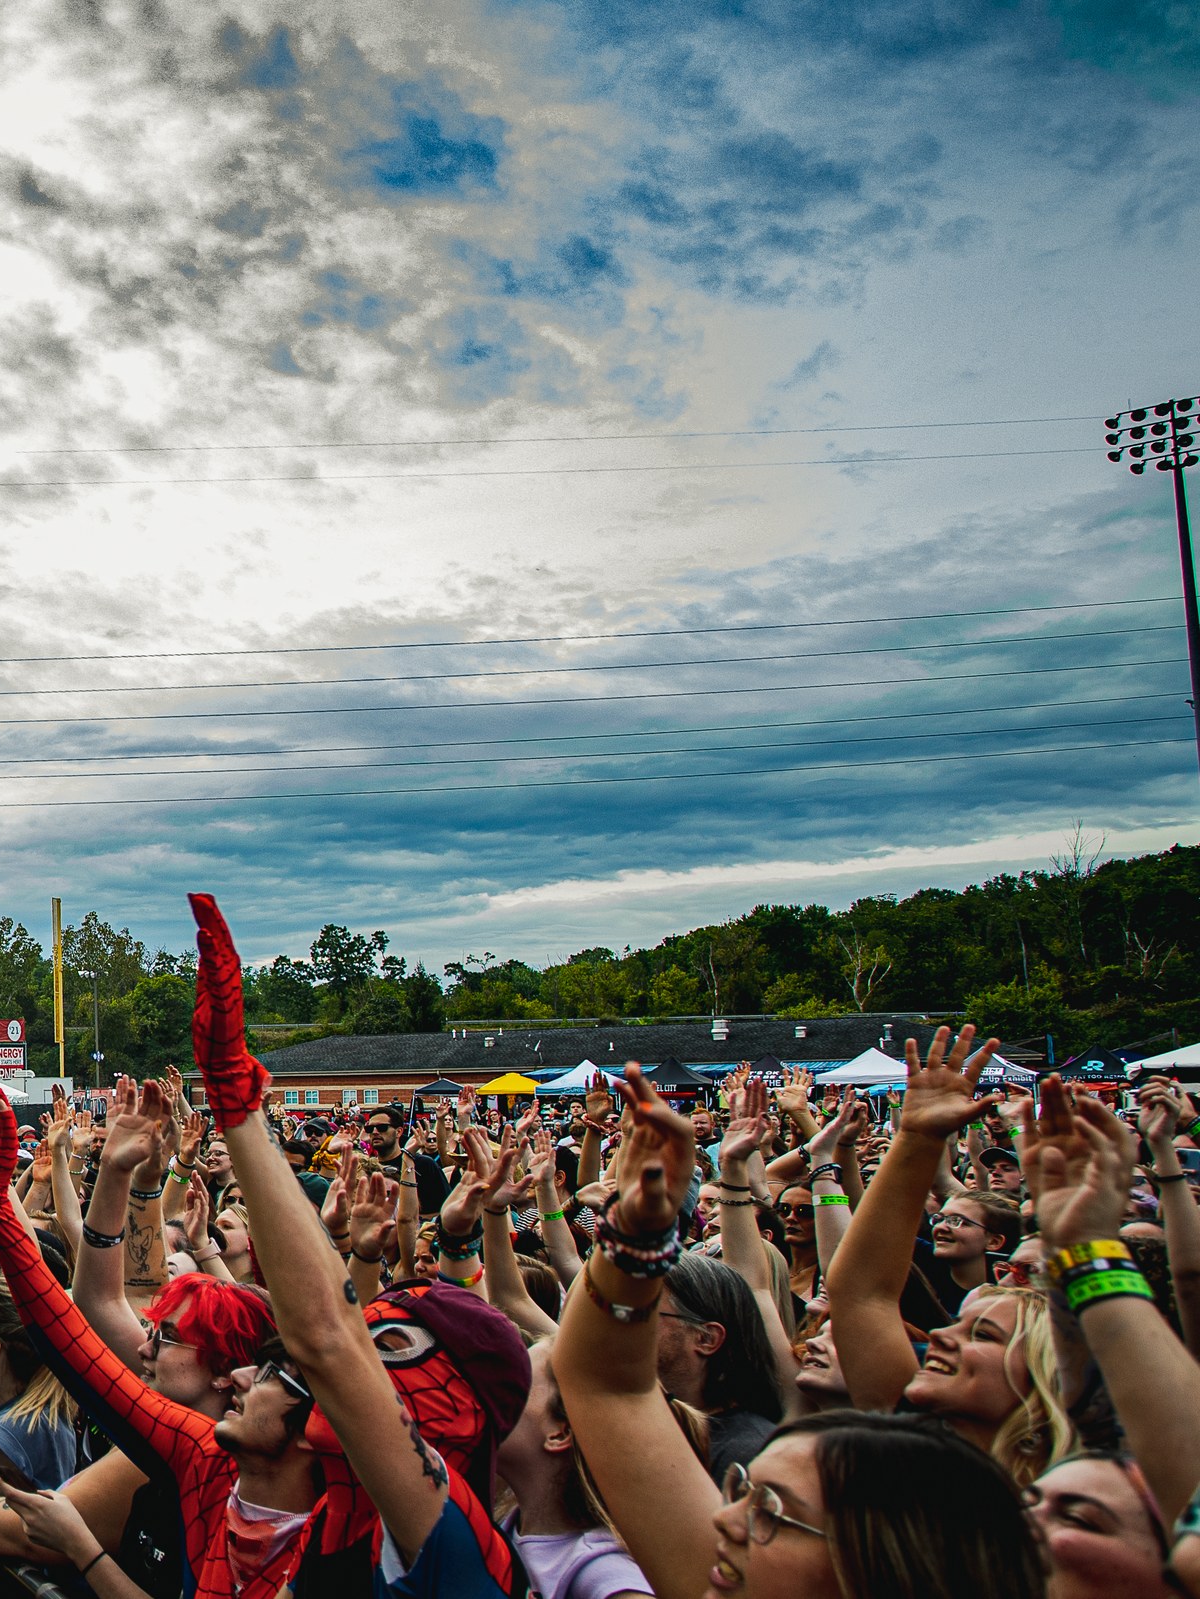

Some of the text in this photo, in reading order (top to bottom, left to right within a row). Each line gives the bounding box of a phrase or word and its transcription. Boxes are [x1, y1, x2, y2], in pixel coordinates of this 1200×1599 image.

[1002, 1074, 1034, 1083] Exhibit
[765, 1079, 782, 1087] THE
[663, 1084, 677, 1092] CITY
